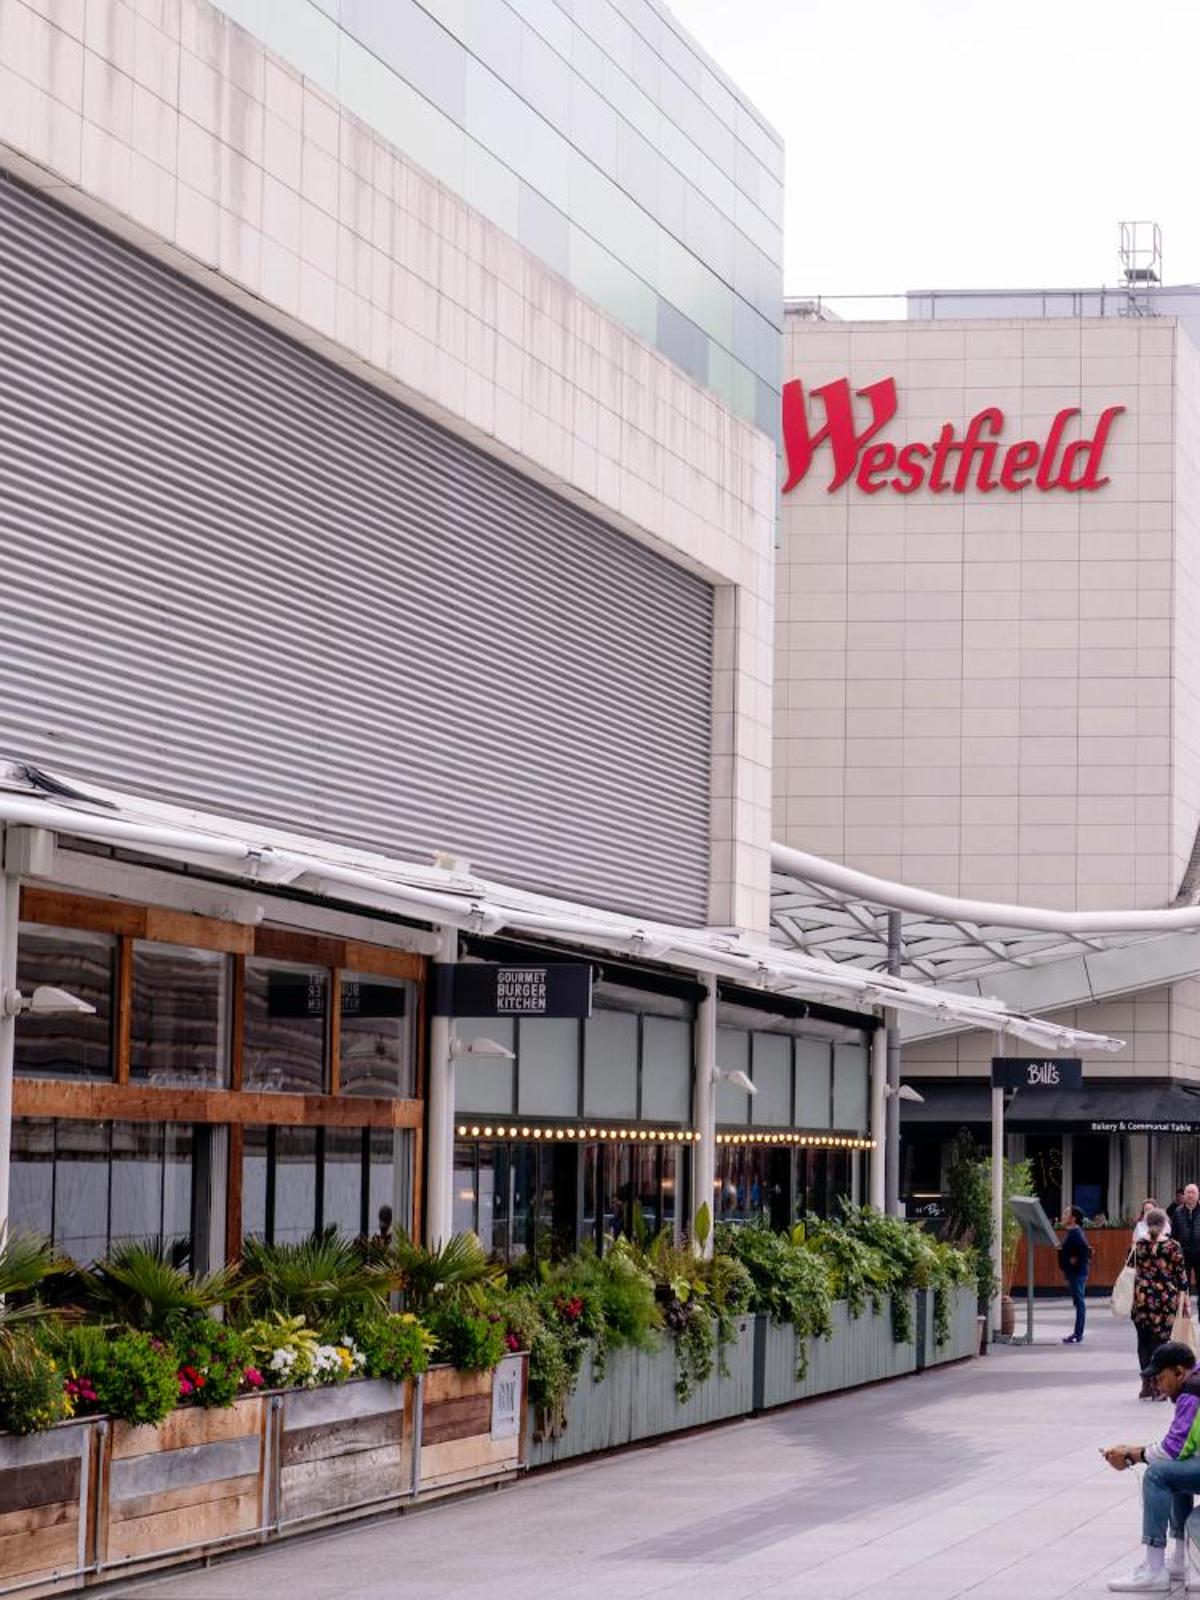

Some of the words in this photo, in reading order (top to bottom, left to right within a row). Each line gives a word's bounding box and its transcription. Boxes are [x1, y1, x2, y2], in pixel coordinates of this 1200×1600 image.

[782, 377, 1126, 494] Westfield
[497, 972, 546, 983] GOURMET
[497, 984, 546, 996] BURGER
[497, 997, 546, 1009] KITCHEN
[1027, 1062, 1060, 1084] Bill's
[1091, 1122, 1117, 1132] Bakery
